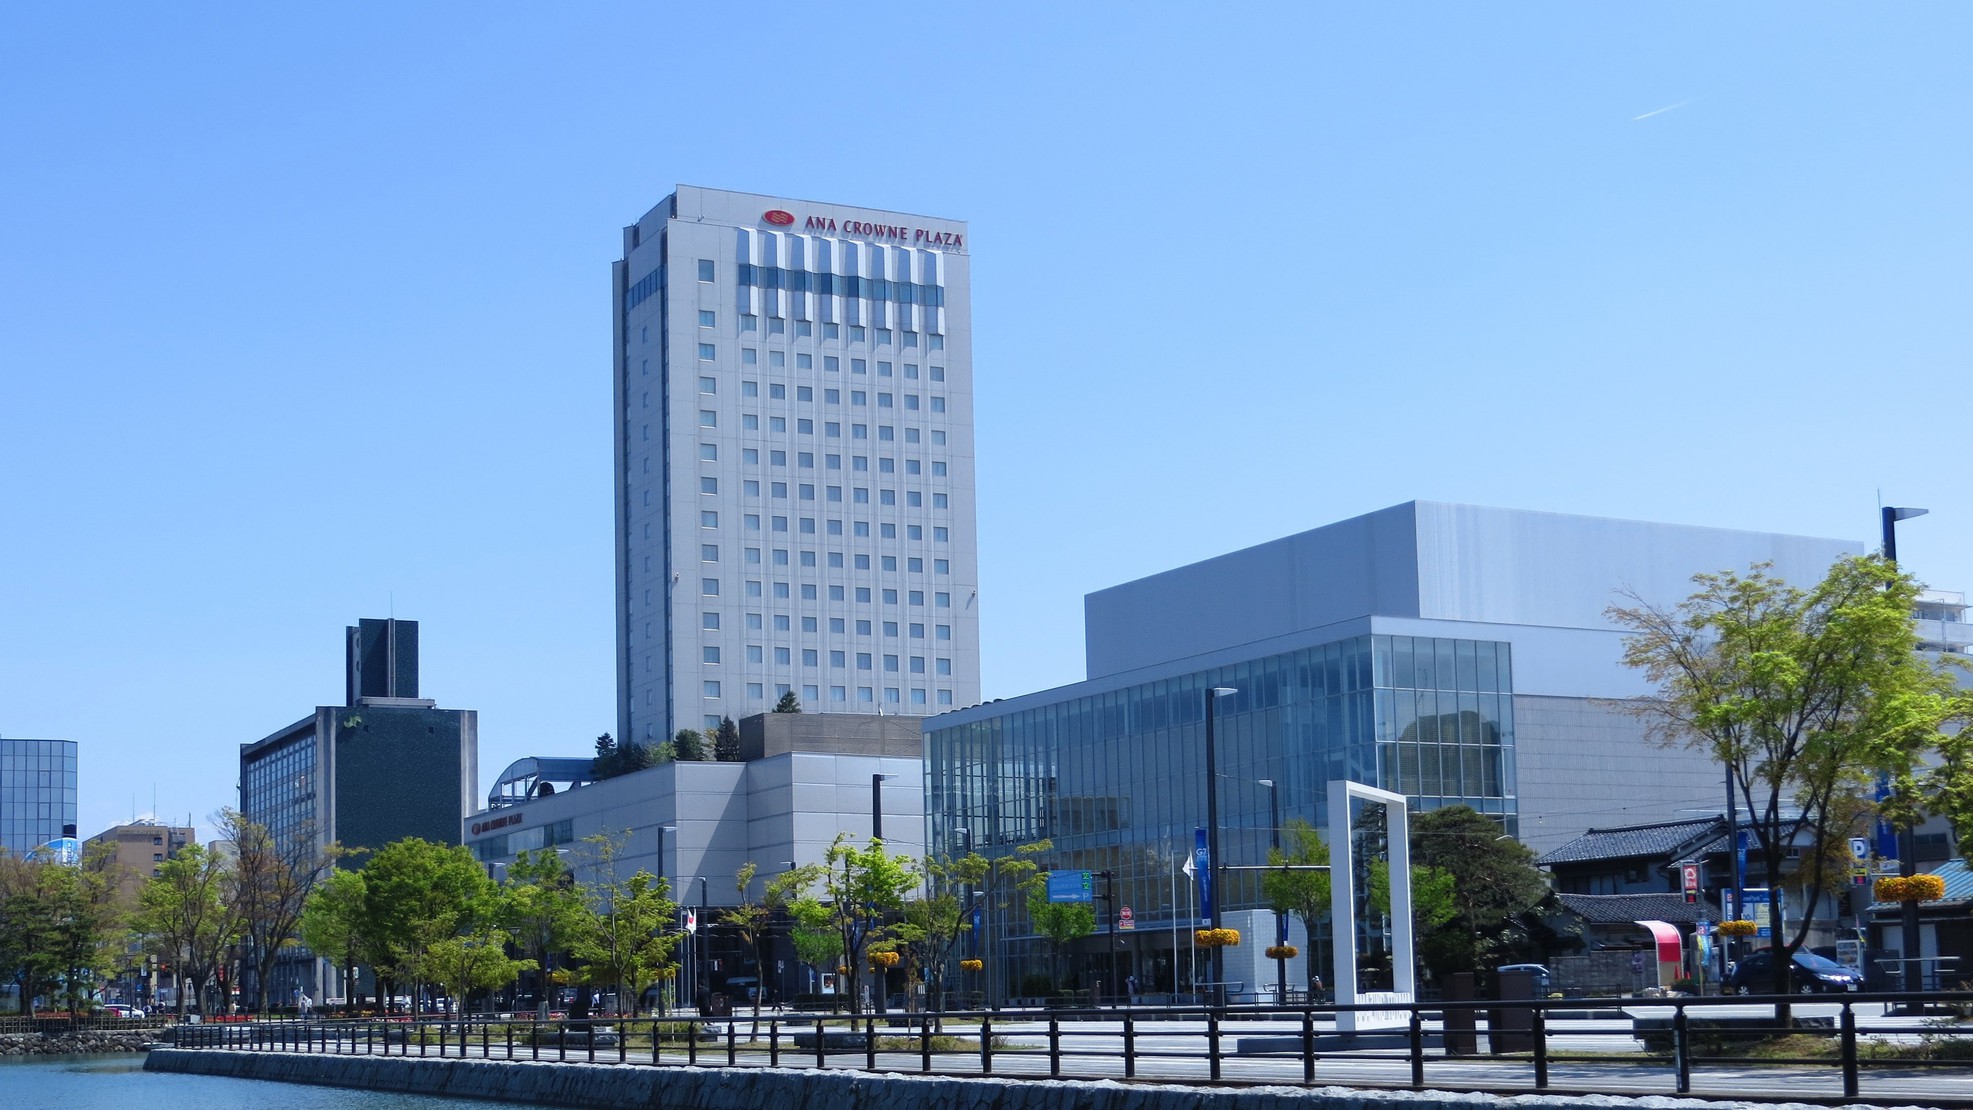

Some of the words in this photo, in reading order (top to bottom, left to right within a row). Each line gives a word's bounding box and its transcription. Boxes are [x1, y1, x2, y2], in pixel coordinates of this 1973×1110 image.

[805, 215, 837, 232] ANA
[843, 220, 908, 240] CROWNE
[916, 229, 963, 247] PLAZA
[1196, 848, 1207, 856] G7
